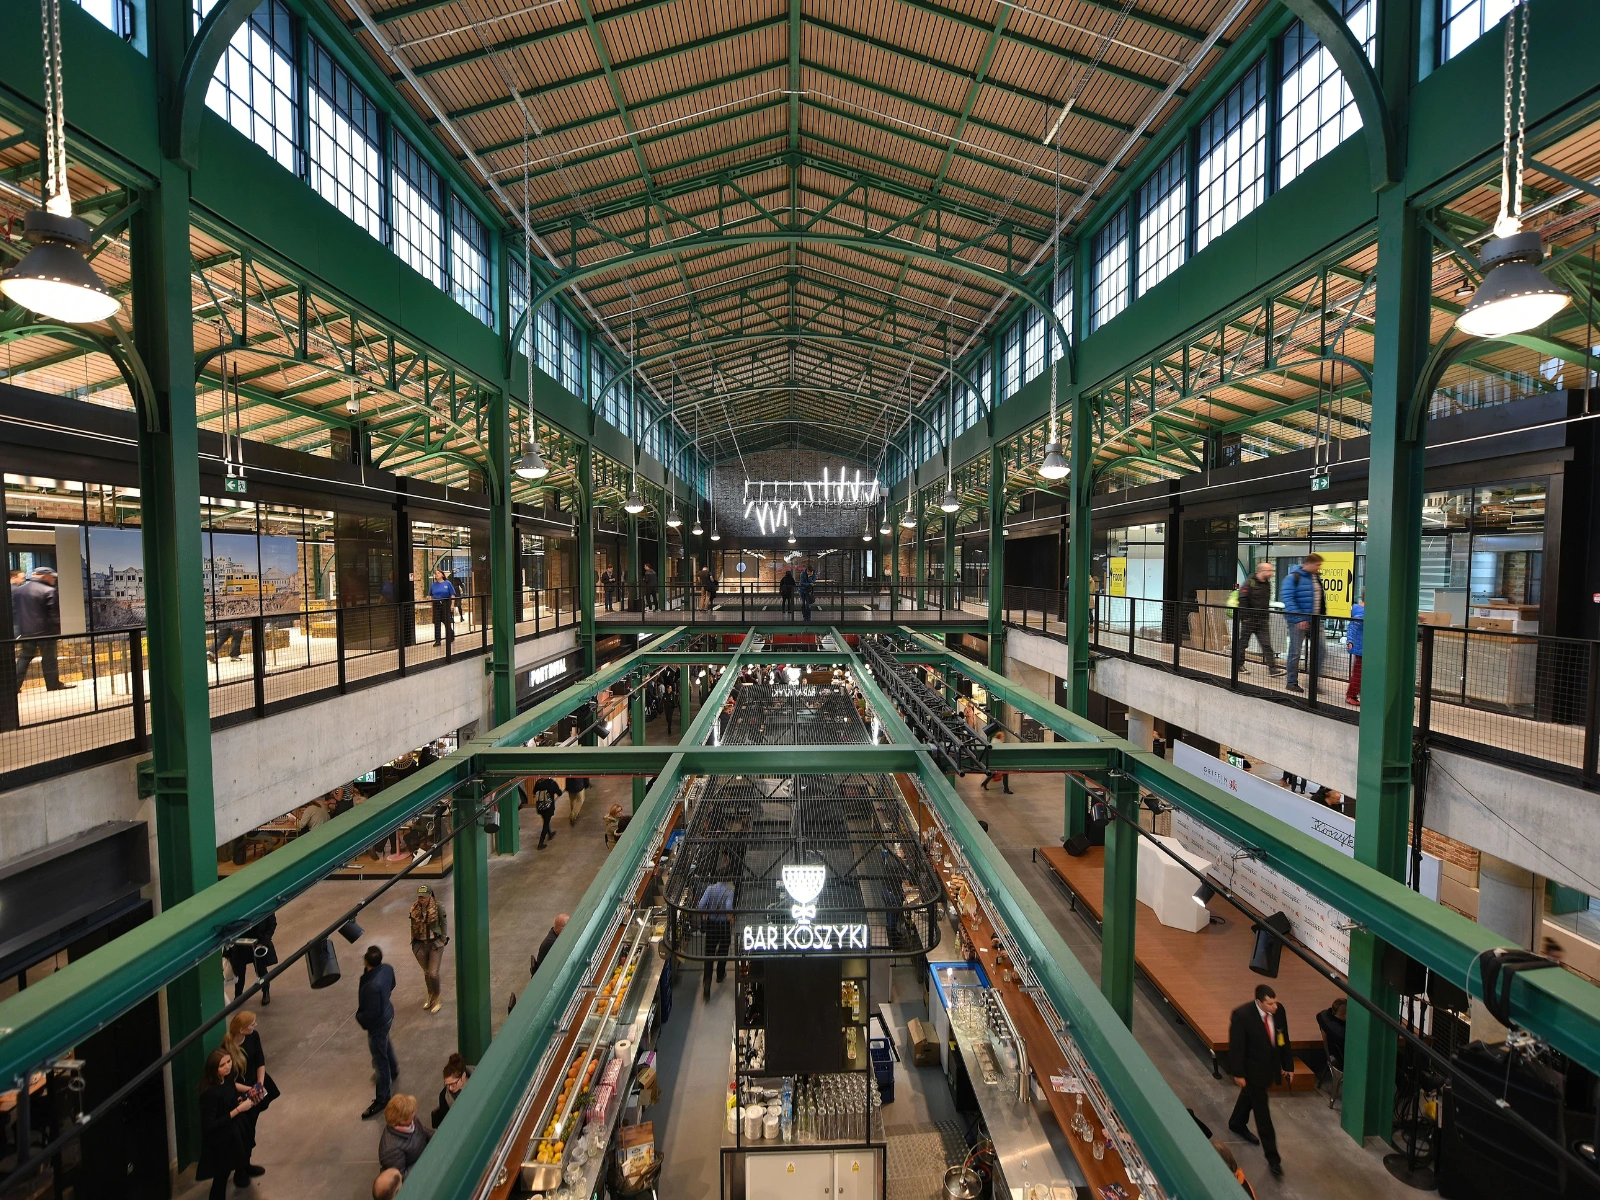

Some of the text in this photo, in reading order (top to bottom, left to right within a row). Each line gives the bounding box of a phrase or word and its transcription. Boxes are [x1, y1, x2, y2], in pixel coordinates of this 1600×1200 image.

[1321, 579, 1343, 591] OOD
[743, 924, 868, 951] BAR KOSZYKI
